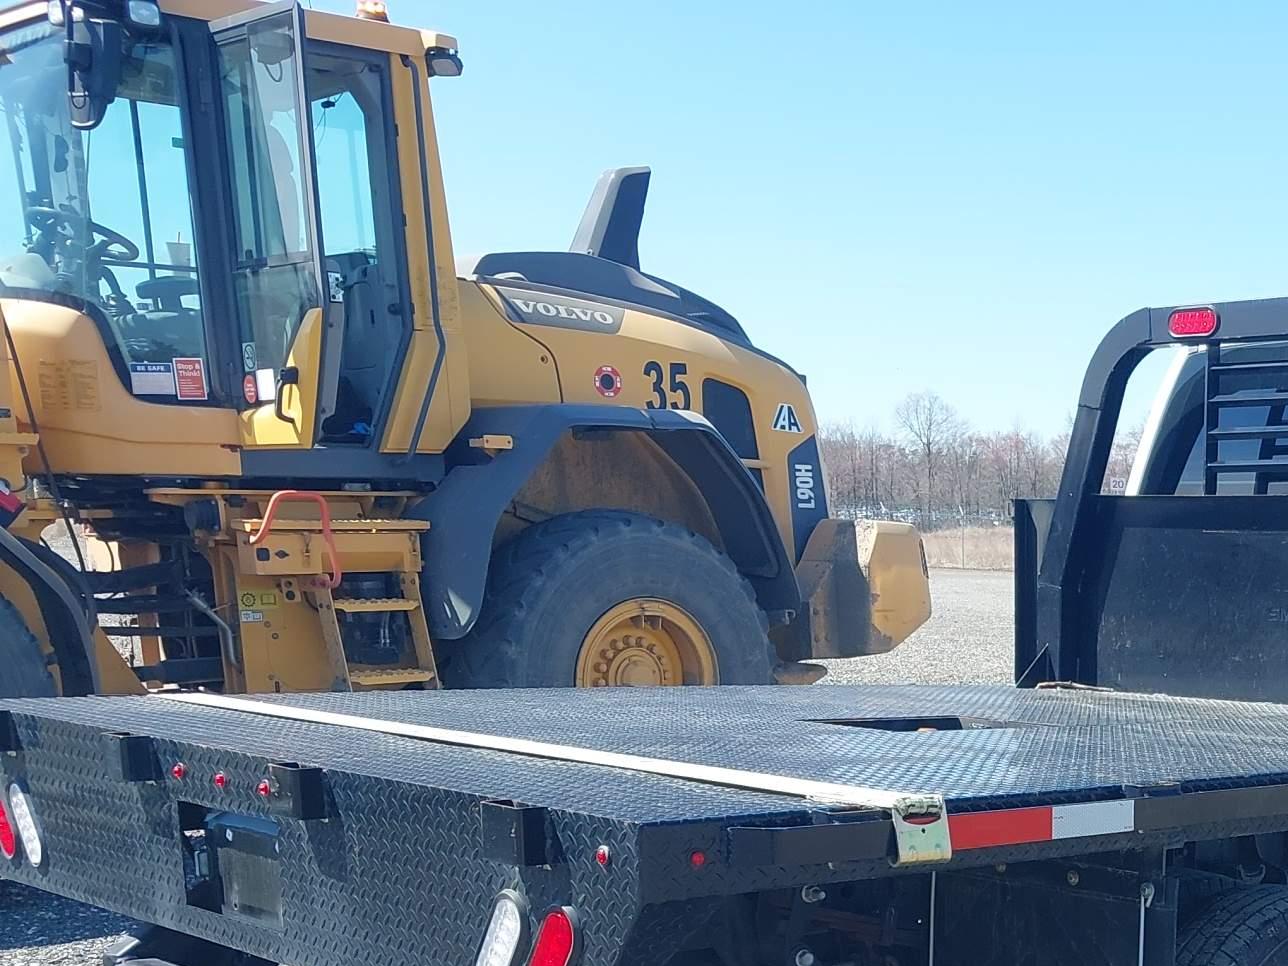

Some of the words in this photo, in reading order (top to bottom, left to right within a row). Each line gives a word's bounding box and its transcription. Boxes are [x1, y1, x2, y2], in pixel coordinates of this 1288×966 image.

[511, 298, 614, 325] VOLVO
[643, 361, 691, 410] 35
[794, 463, 815, 509] L90H
[1112, 479, 1125, 489] 20
